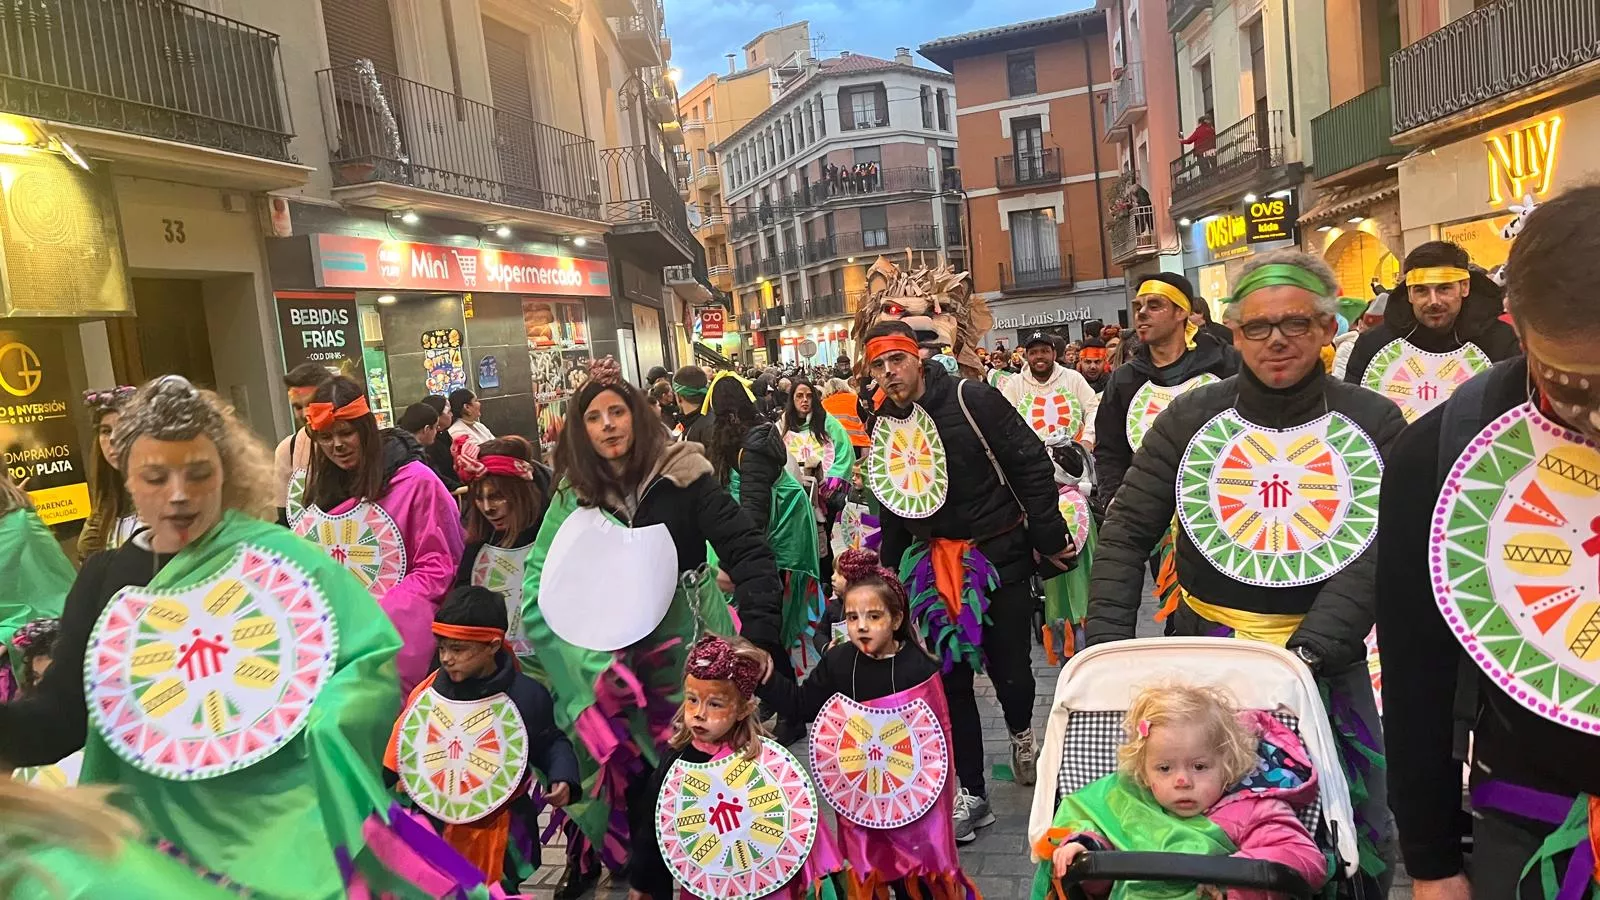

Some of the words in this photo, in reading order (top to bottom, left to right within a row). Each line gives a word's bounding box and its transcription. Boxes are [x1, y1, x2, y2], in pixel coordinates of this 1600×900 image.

[1250, 200, 1284, 217] OVS
[162, 219, 186, 244] 33
[1206, 216, 1228, 250] OVS
[1445, 228, 1477, 243] Precios
[411, 248, 449, 279] Mini
[483, 254, 582, 290] Supermercado
[290, 308, 349, 325] BEBIDAS
[992, 317, 1018, 330] Jean
[1021, 312, 1054, 327] Louis
[1057, 306, 1091, 322] David
[302, 326, 346, 348] FRÍAS
[16, 400, 66, 415] INVERSIÓN
[10, 415, 44, 424] GRUPO
[4, 444, 70, 465] OMPRAMOS
[8, 466, 26, 479] RO
[26, 466, 35, 476] Y
[36, 460, 73, 476] PLATA
[37, 499, 73, 510] PARENCIA
[41, 507, 78, 519] ENCIALIDAD
